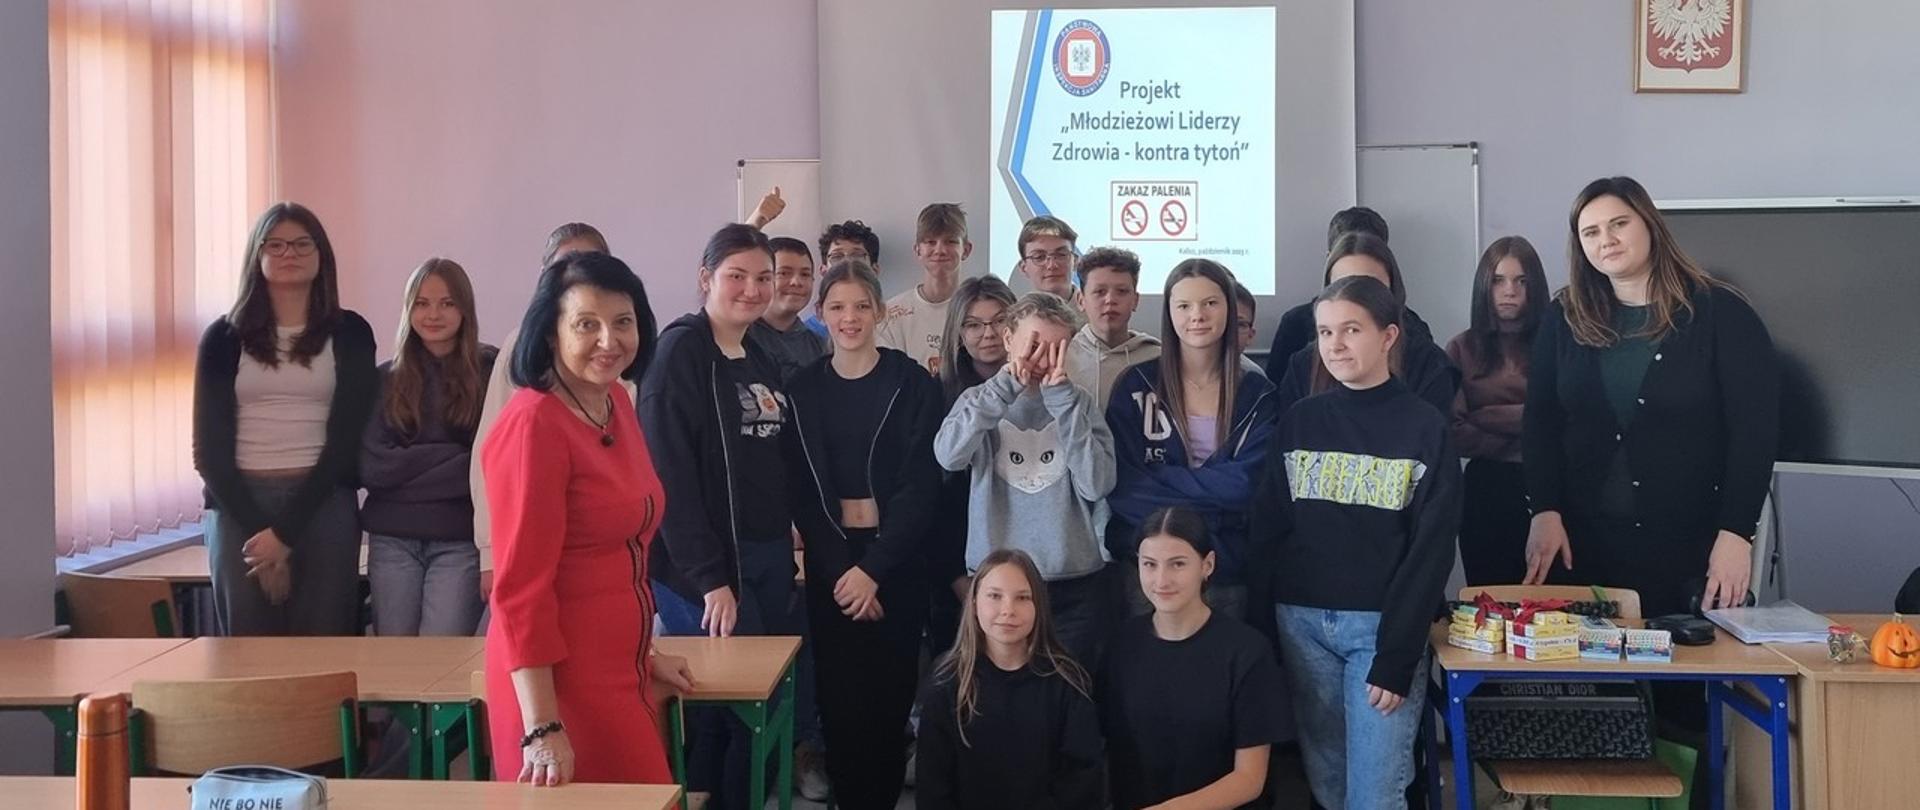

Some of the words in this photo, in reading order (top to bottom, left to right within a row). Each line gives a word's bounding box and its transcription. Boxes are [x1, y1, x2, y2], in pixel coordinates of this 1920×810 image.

[1120, 80, 1181, 104] Projekt
[1061, 112, 1174, 134] „Młodzieżowi
[1178, 112, 1241, 134] Liderzy
[1052, 142, 1120, 161] Zdrowia
[1135, 142, 1189, 161] kontra
[1117, 186, 1149, 197] ZAKAZ
[1151, 186, 1191, 197] PALENIA
[1501, 684, 1563, 696] CHRISTIAN
[1568, 684, 1597, 696] DIOR
[210, 797, 231, 810] NIE
[236, 798, 256, 810] BO
[260, 797, 283, 810] NIE
